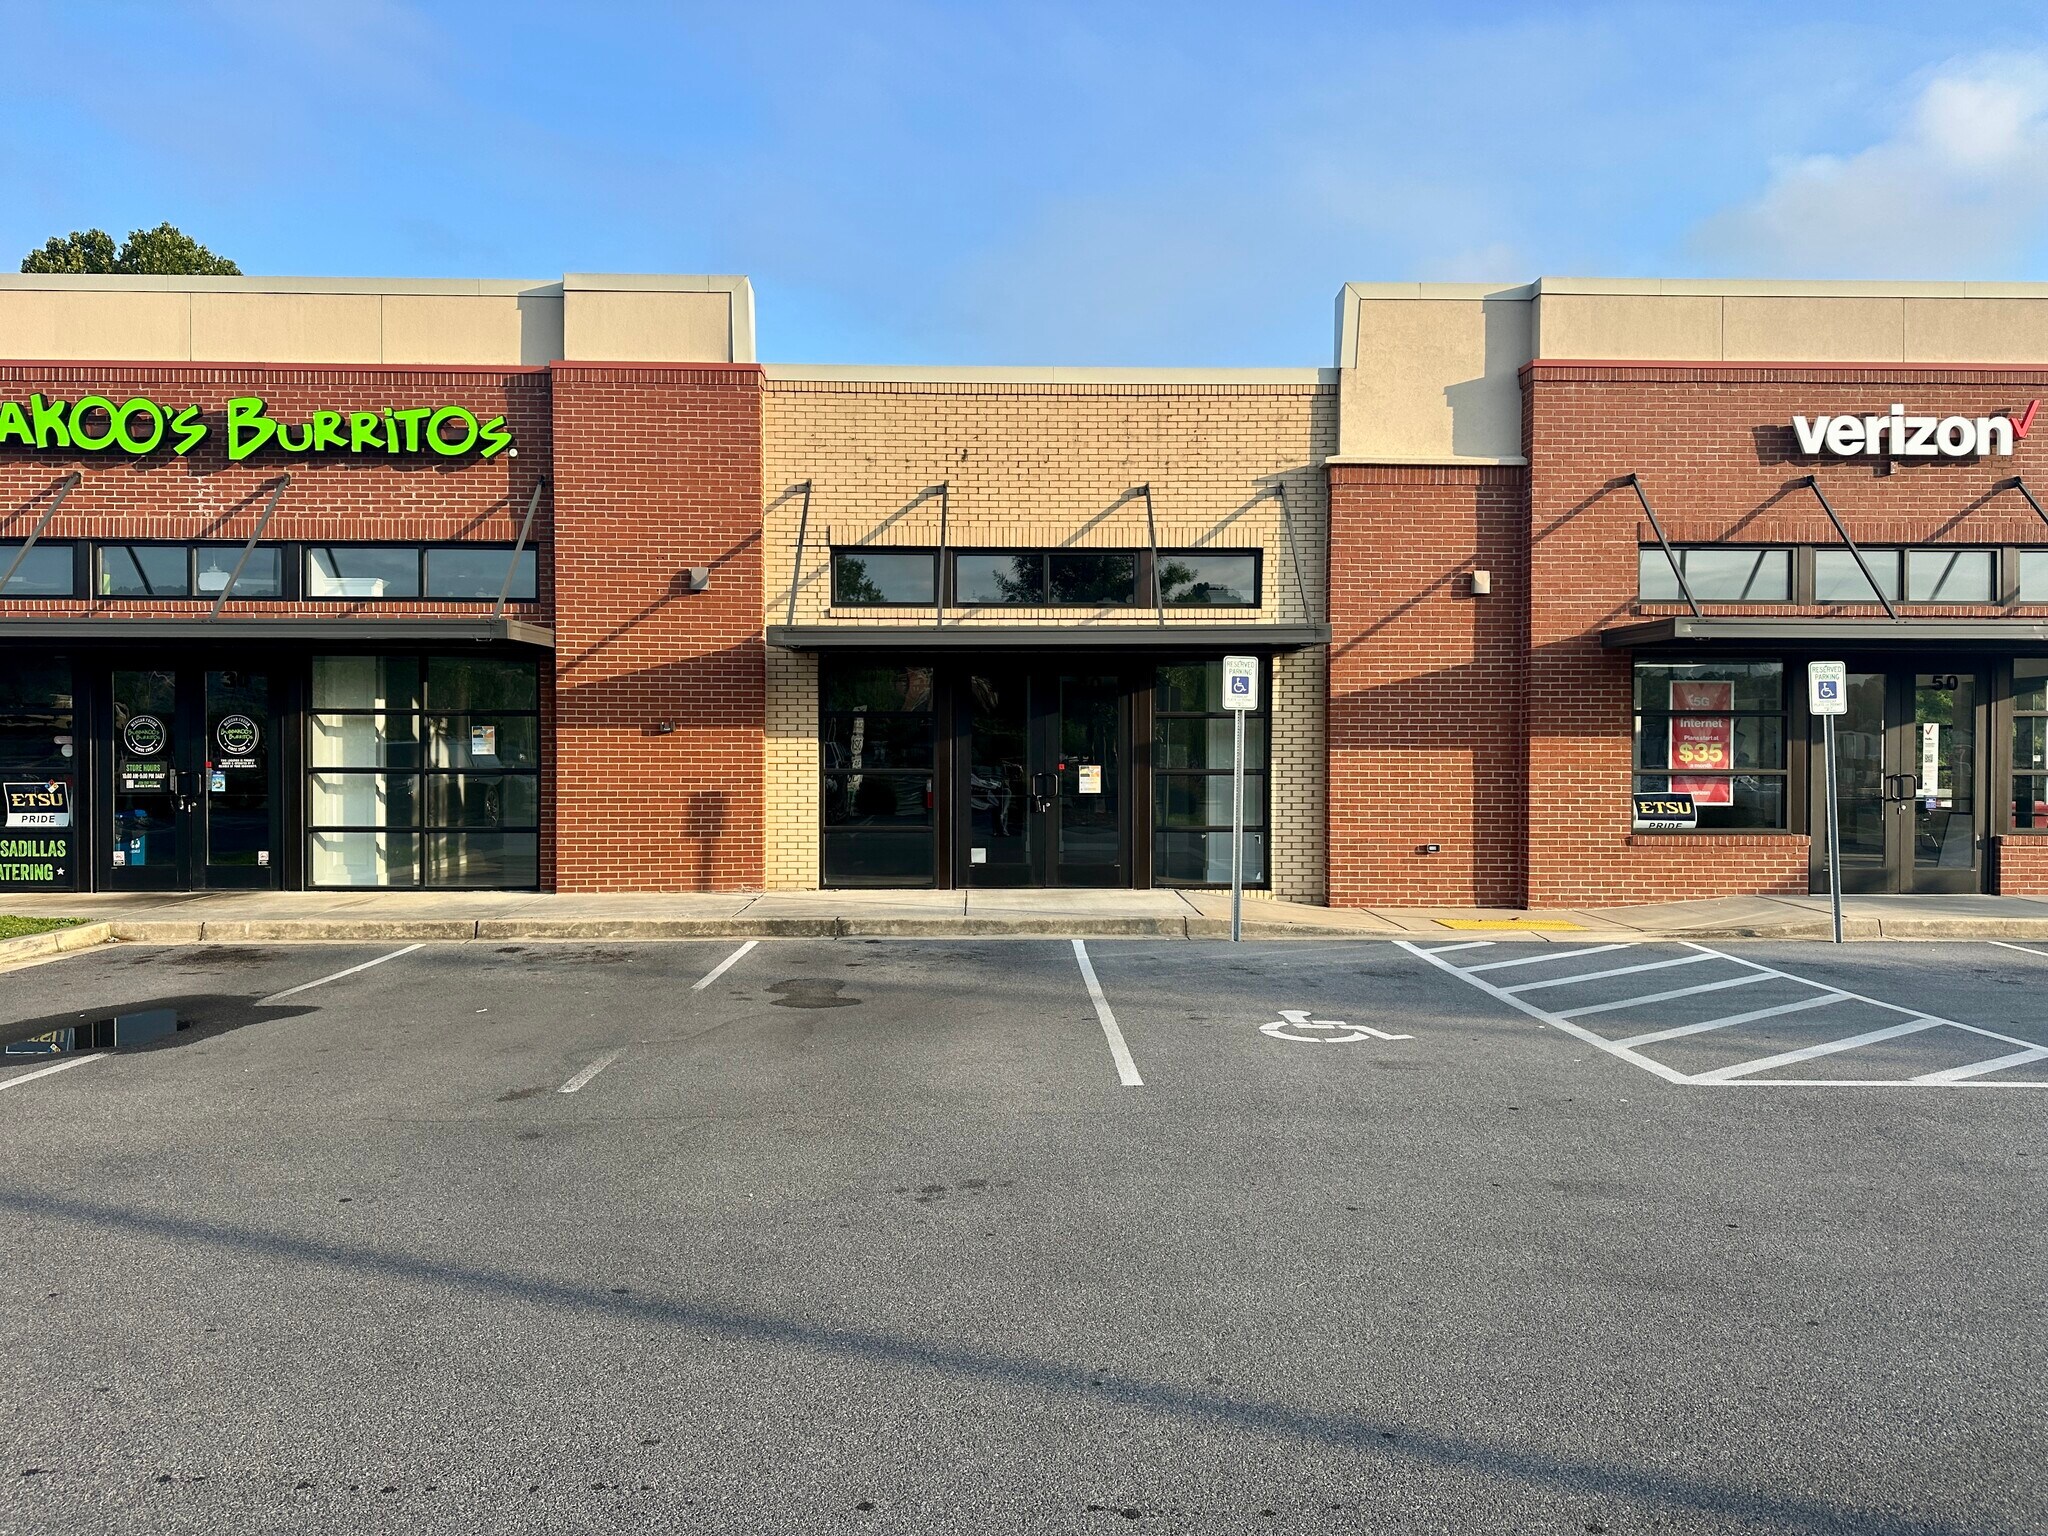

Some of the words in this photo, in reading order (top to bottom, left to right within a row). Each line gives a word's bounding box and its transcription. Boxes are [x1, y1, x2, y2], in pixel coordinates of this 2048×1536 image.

[1792, 403, 2013, 456] verizon
[1931, 675, 1958, 691] 50
[1693, 696, 1710, 707] 5G
[1680, 718, 1723, 728] Internet
[1678, 742, 1723, 764] $35
[126, 764, 142, 772] STORE
[143, 764, 161, 772] HOURS
[11, 793, 63, 807] ETSU
[1639, 801, 1691, 814] ETSU
[21, 815, 56, 823] PRIDE
[0, 839, 66, 858] SADILLAS
